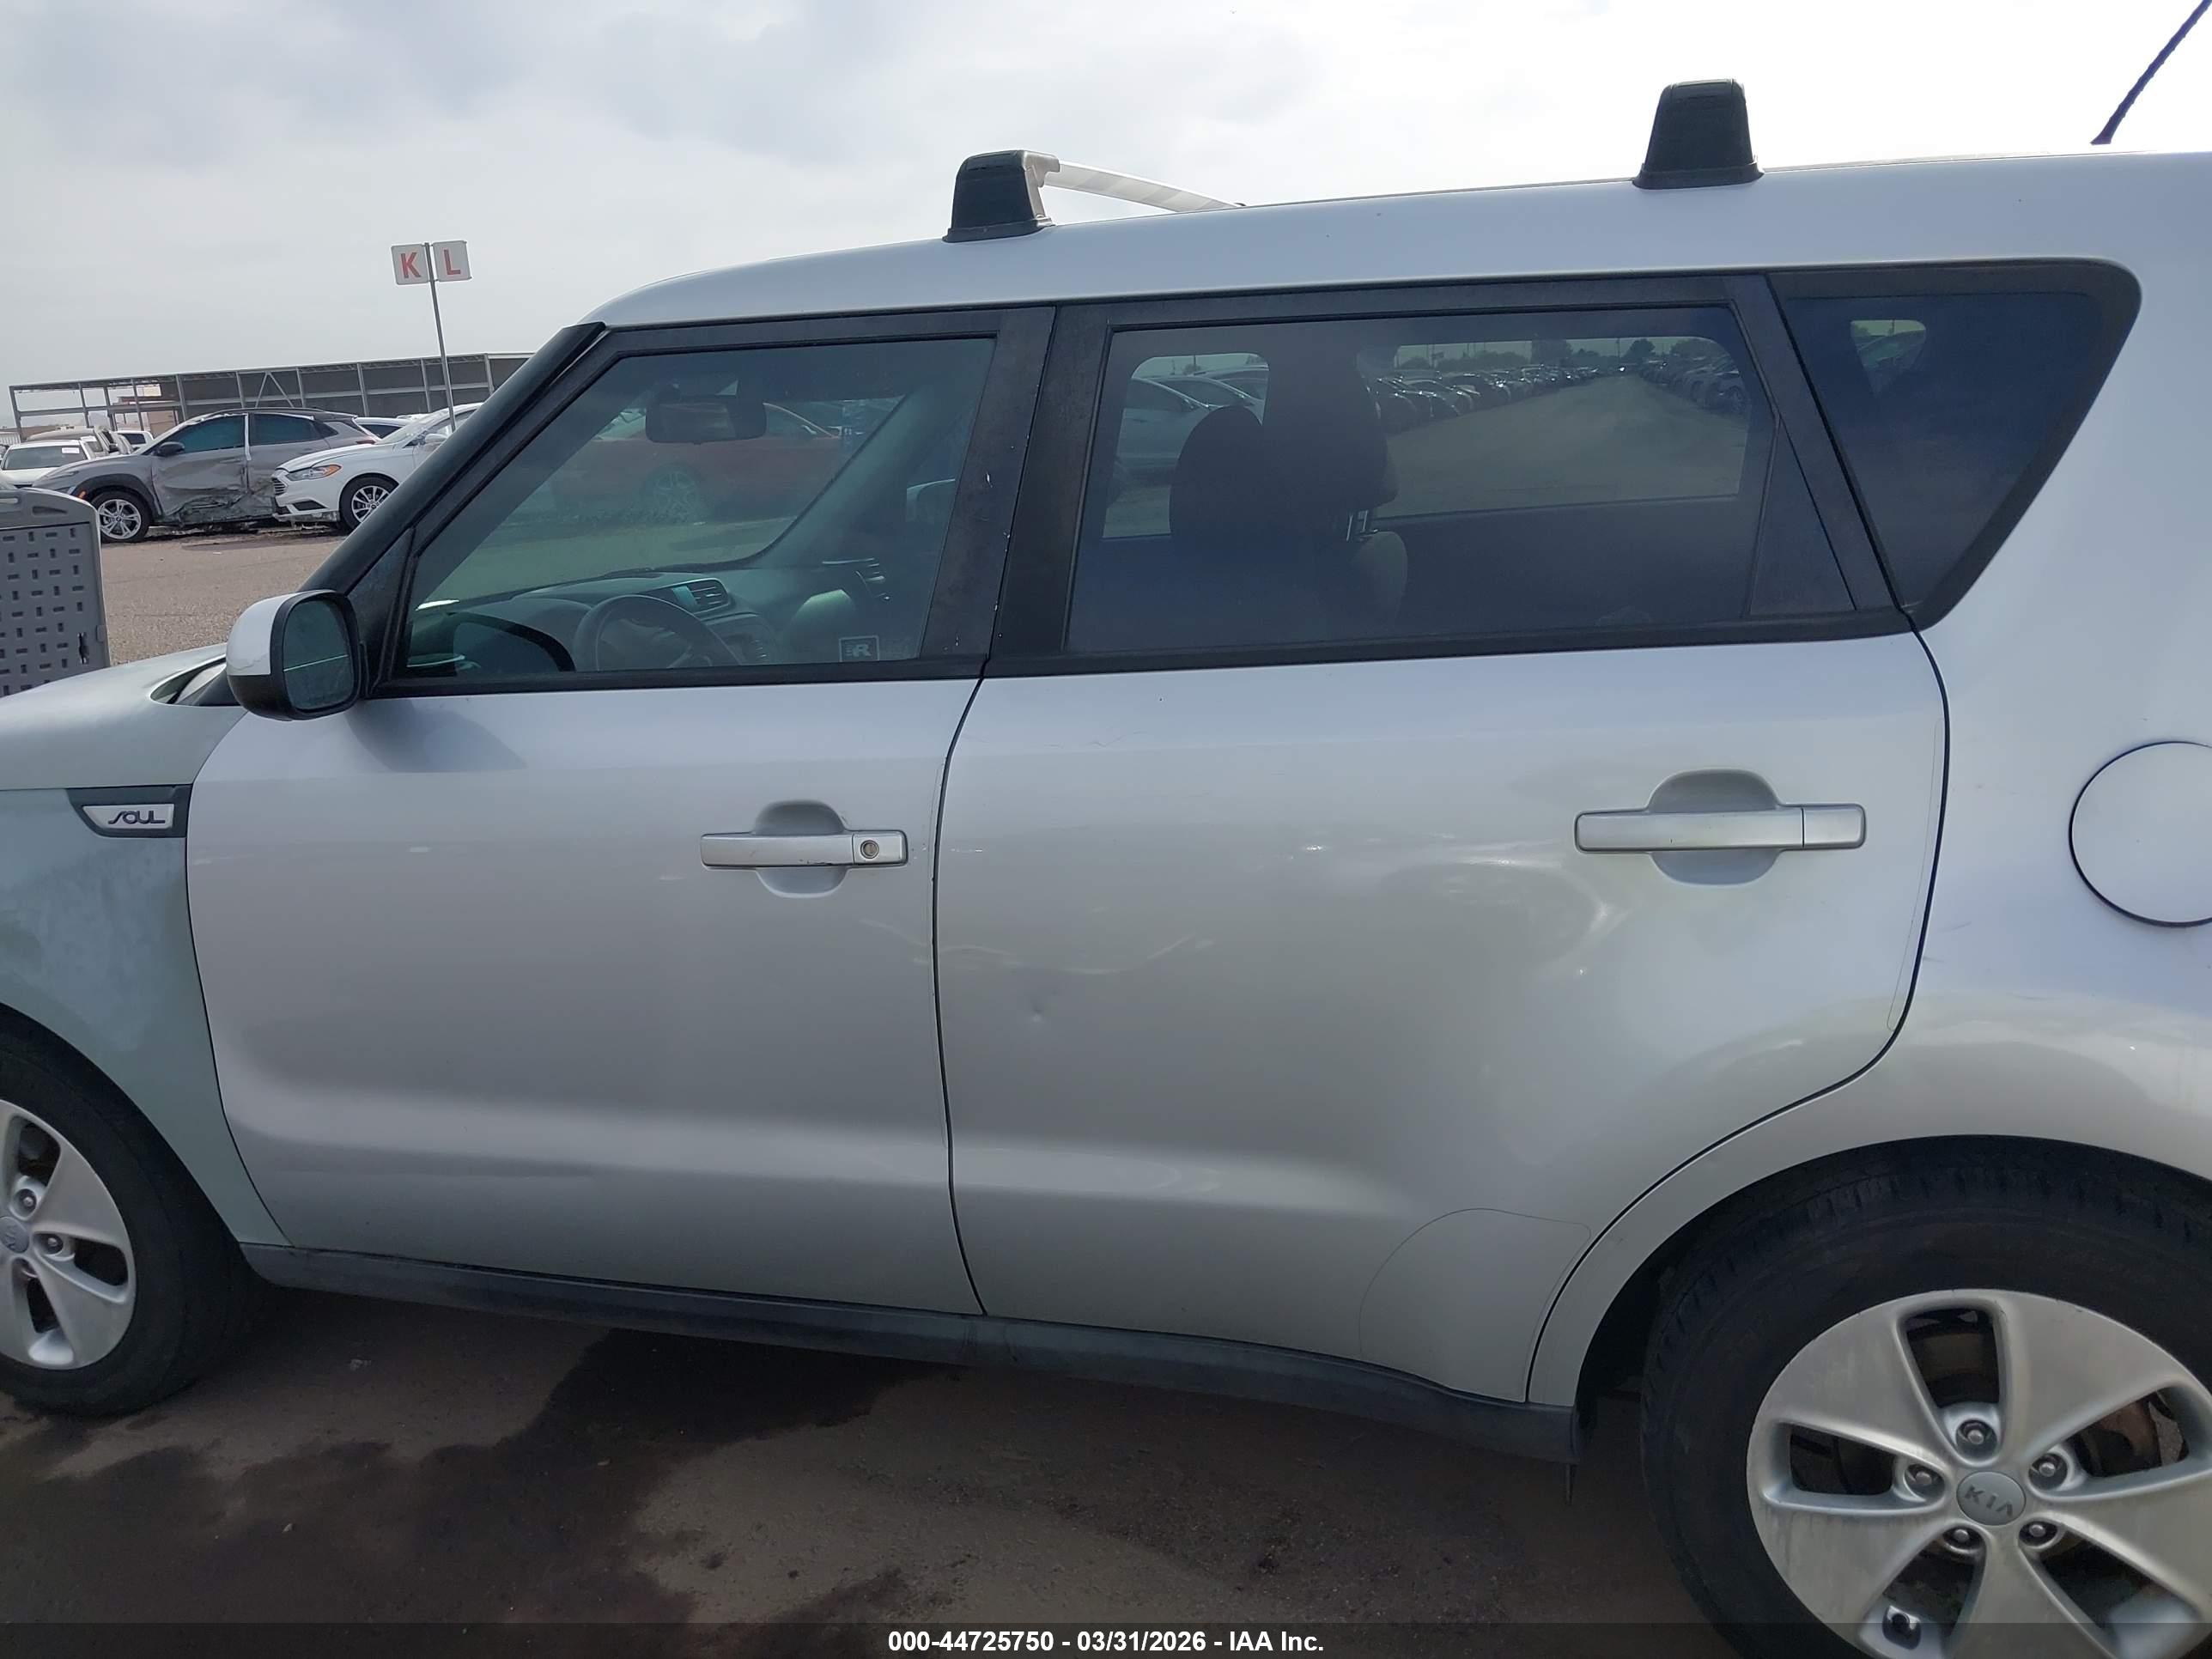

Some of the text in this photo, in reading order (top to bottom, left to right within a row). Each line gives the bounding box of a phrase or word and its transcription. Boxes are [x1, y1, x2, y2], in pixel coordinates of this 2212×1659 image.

[400, 252, 422, 279] K
[443, 249, 461, 276] L
[1964, 1485, 2014, 1518] KIA
